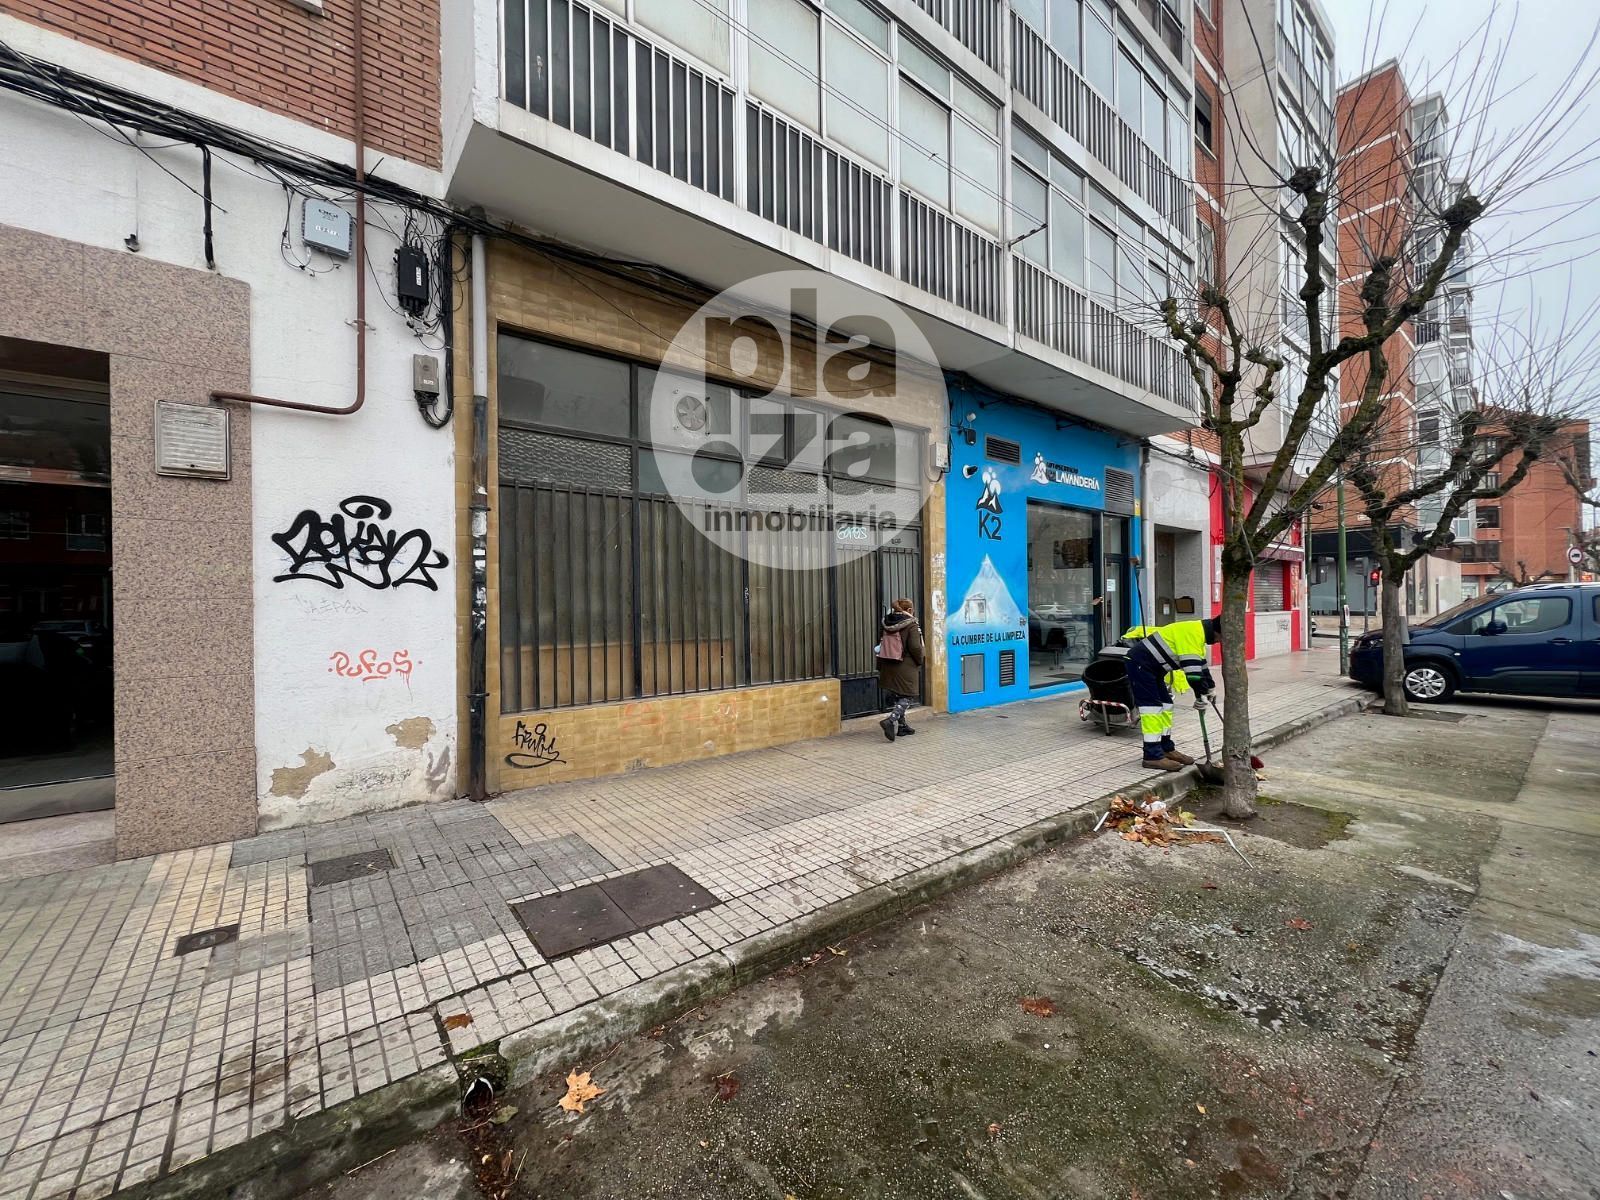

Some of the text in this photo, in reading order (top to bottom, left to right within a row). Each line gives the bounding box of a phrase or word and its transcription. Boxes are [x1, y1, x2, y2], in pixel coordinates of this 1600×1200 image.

[1055, 470, 1100, 490] LAVANDERÍA
[978, 510, 1002, 540] K2
[952, 630, 1026, 646] LA CUMBRE DE LA LIMPIEZA
